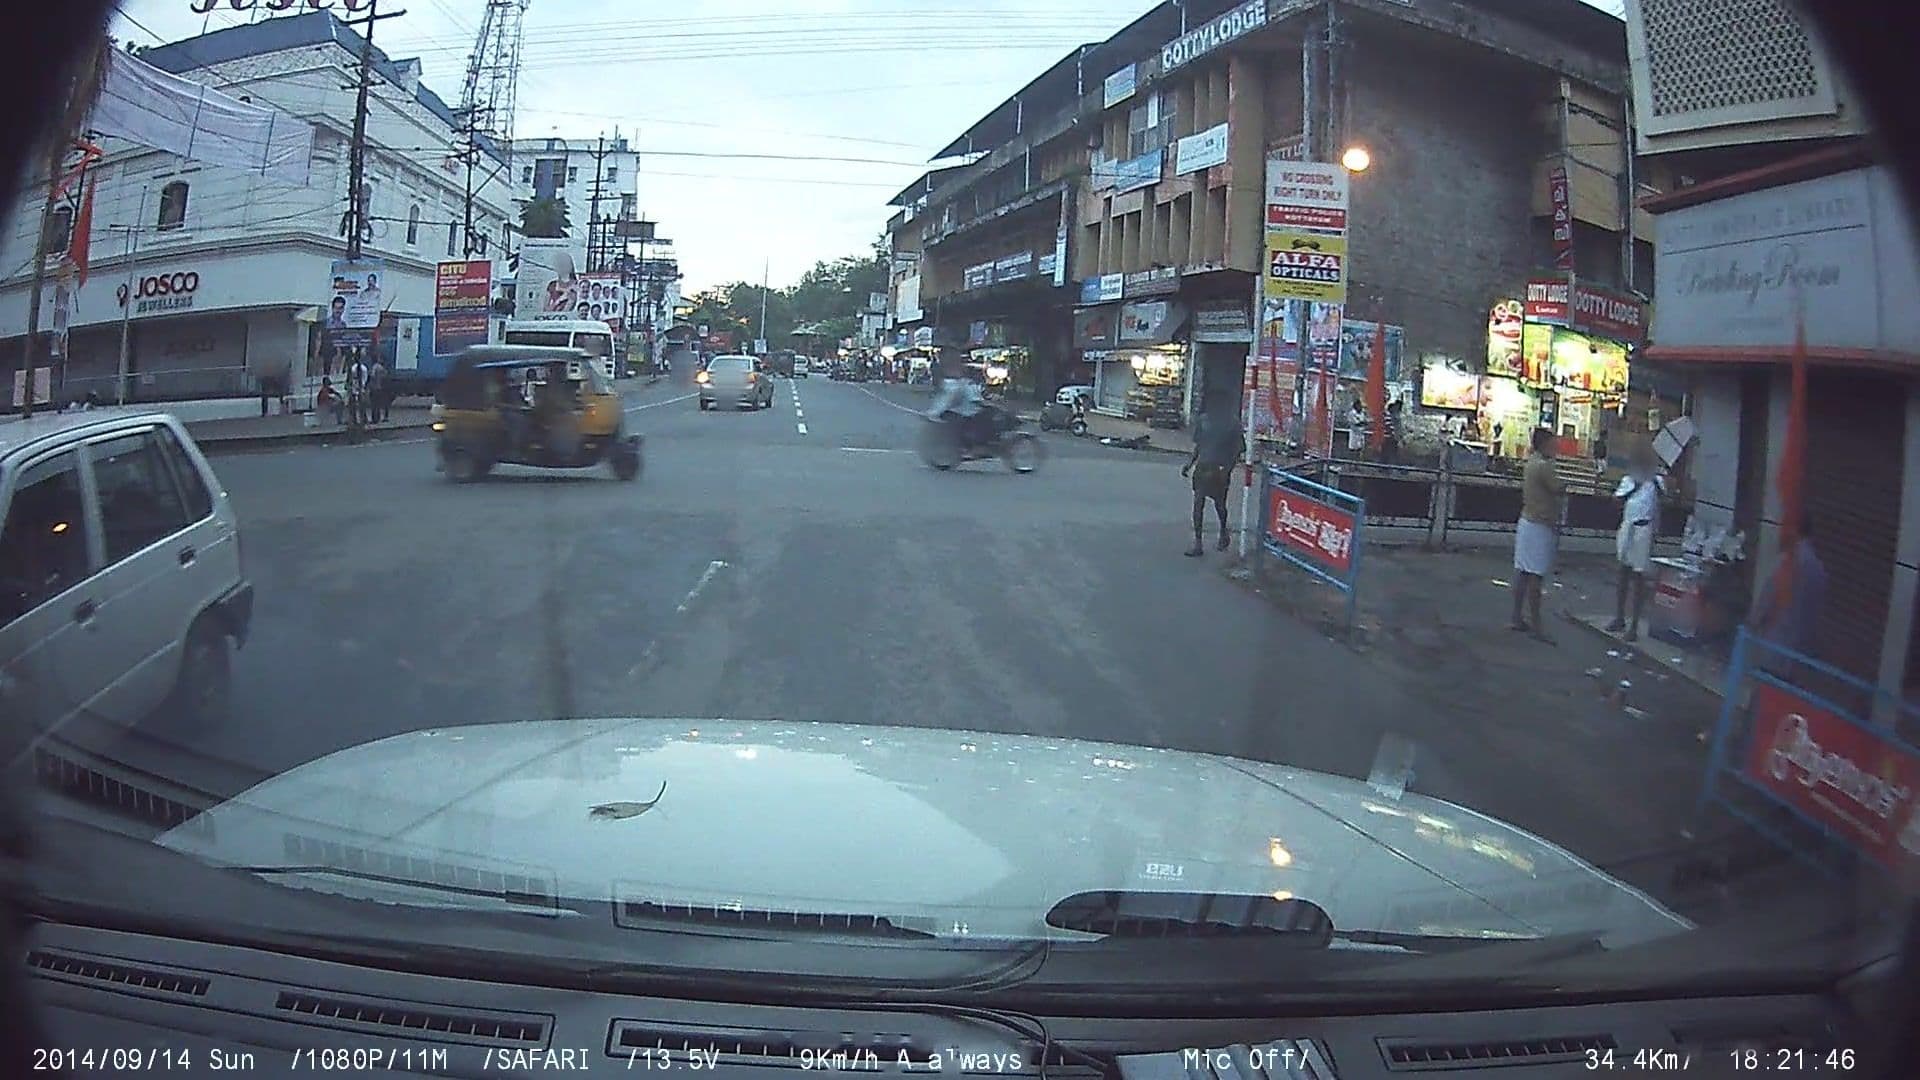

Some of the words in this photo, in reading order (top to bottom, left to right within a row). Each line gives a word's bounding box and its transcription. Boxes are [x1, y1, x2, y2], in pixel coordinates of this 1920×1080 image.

[1273, 186, 1297, 198] RIGHT
[1299, 187, 1320, 200] TURN
[1322, 189, 1343, 201] ONLY
[1273, 205, 1309, 215] TRAFFIC
[1272, 251, 1341, 270] ALFA
[1272, 266, 1340, 281] OPTICALS
[133, 271, 200, 300] JOSCO
[1527, 283, 1548, 303] DOTTY
[1547, 284, 1569, 304] LODGE
[1575, 291, 1609, 318] DOTTY
[1608, 298, 1640, 326] LODGE
